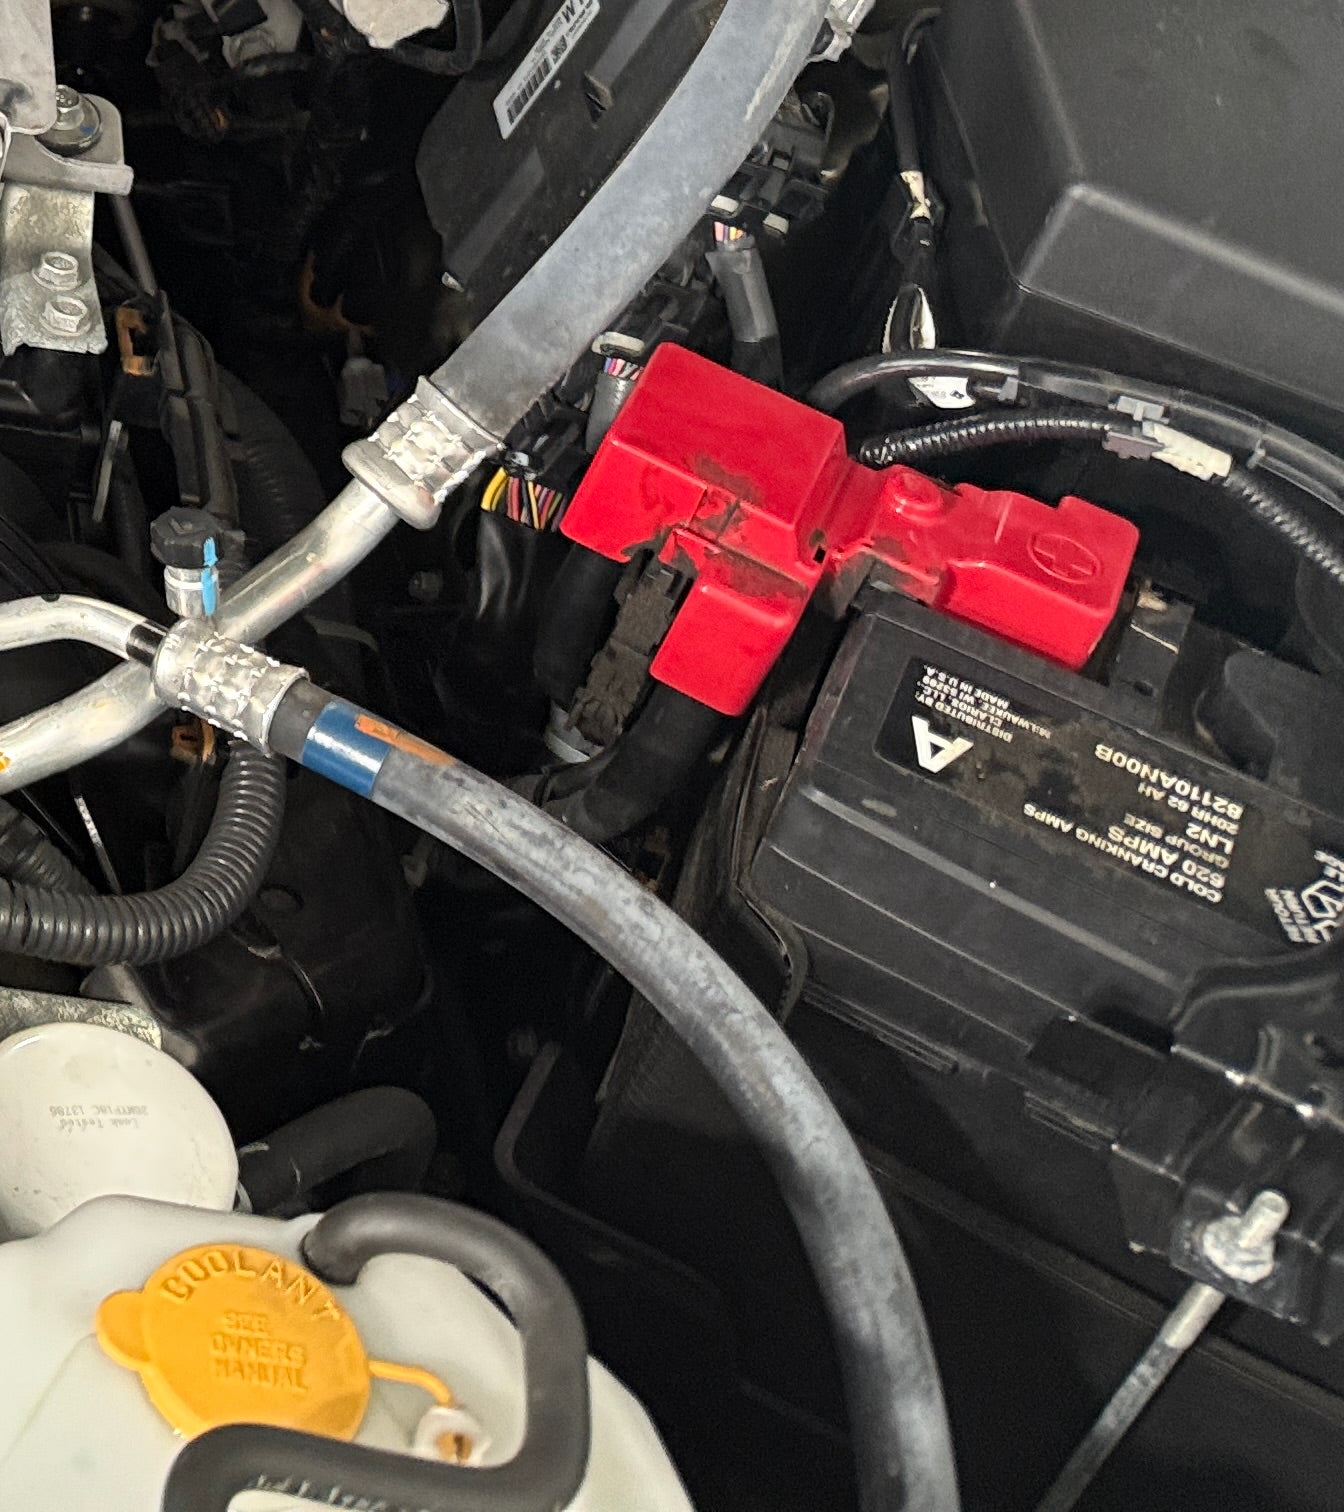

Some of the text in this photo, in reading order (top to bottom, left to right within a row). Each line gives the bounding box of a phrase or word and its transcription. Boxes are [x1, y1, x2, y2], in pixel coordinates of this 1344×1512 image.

[959, 681, 973, 693] IN
[973, 688, 1009, 710] MADE
[934, 701, 1013, 742] DISTRIBUTED
[1136, 781, 1166, 801] AH
[1020, 802, 1222, 903] COLD CRANKING AMPS
[1122, 812, 1229, 868] GROUP SIZE
[1183, 821, 1234, 854] LN2
[1104, 824, 1226, 888] 620 AMPS
[160, 1250, 341, 1321] COOLANT
[223, 1311, 271, 1336] SEE
[210, 1334, 307, 1367] OWNERS
[210, 1358, 308, 1392] MANUAL
